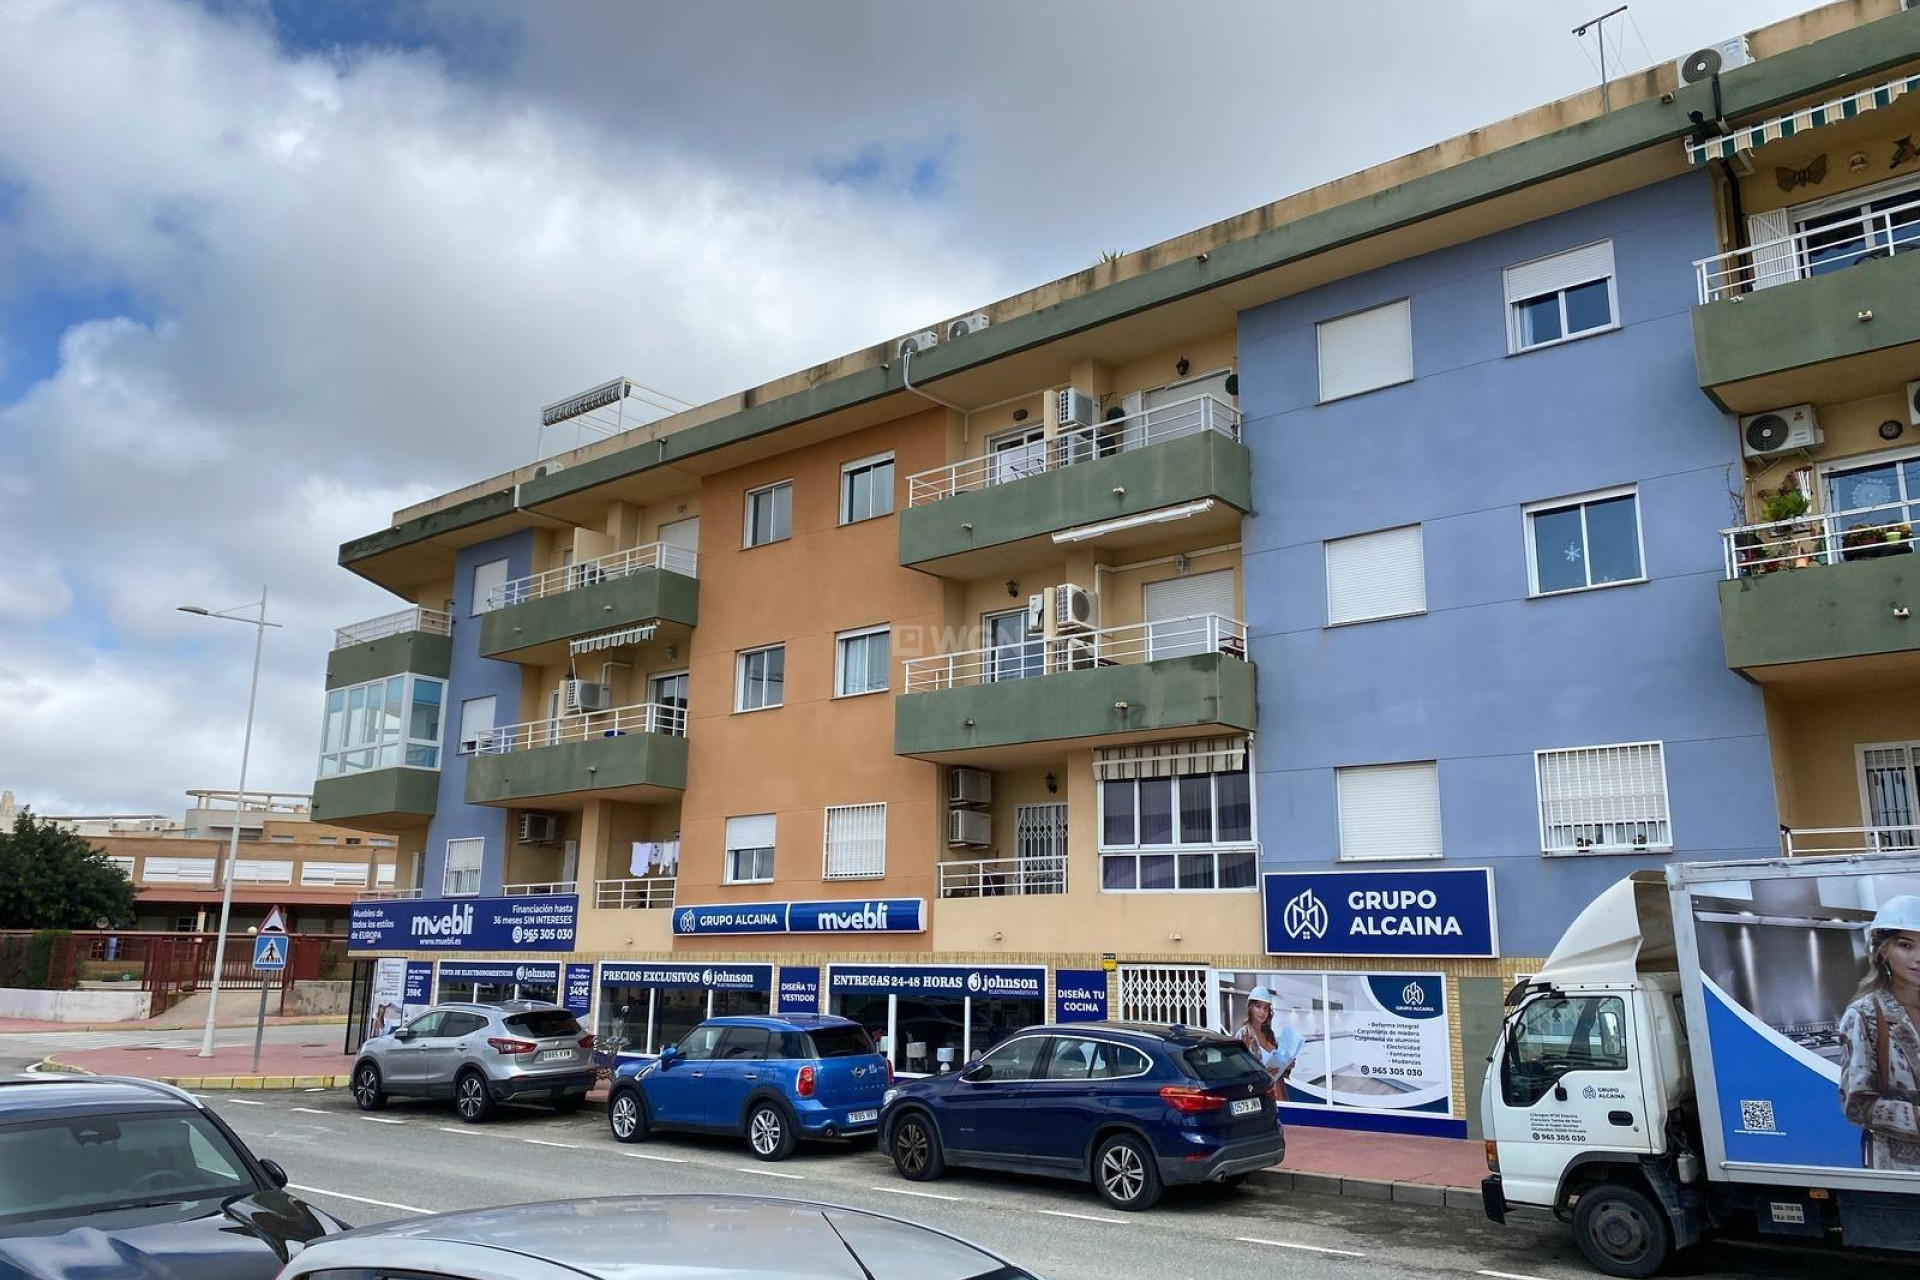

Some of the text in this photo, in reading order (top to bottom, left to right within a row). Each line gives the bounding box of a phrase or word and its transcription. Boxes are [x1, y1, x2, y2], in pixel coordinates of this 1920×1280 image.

[1348, 889, 1437, 910] GRUPO
[353, 909, 384, 917] Muebles de
[512, 904, 573, 914] Financiación hasta
[411, 904, 474, 935] muebli
[493, 915, 573, 925] 36 meses SIN INTERESES
[700, 913, 778, 926] GRUPO ALCAINA
[818, 902, 888, 930] muebli
[352, 919, 394, 928] todos los estilos
[1349, 916, 1463, 936] ALCAINA
[351, 931, 382, 939] de EUROPA
[523, 929, 573, 940] 965 305 030
[419, 937, 461, 945] www.muebli.es
[524, 967, 556, 980] johnson
[603, 970, 641, 982] PRECIOS
[643, 971, 700, 983] EXCLUSIVOS
[712, 971, 754, 985] johnson
[781, 982, 816, 991] DISEÑA TU
[833, 975, 962, 988] ENTREGAS 24-48 HORAS
[982, 973, 1038, 992] johnson
[569, 986, 589, 996] 349€
[1058, 988, 1105, 999] DISEÑA TU
[781, 993, 815, 1002] VESTIDOR
[1064, 1002, 1099, 1012] COCINA
[1372, 1067, 1423, 1077] 965 305 030
